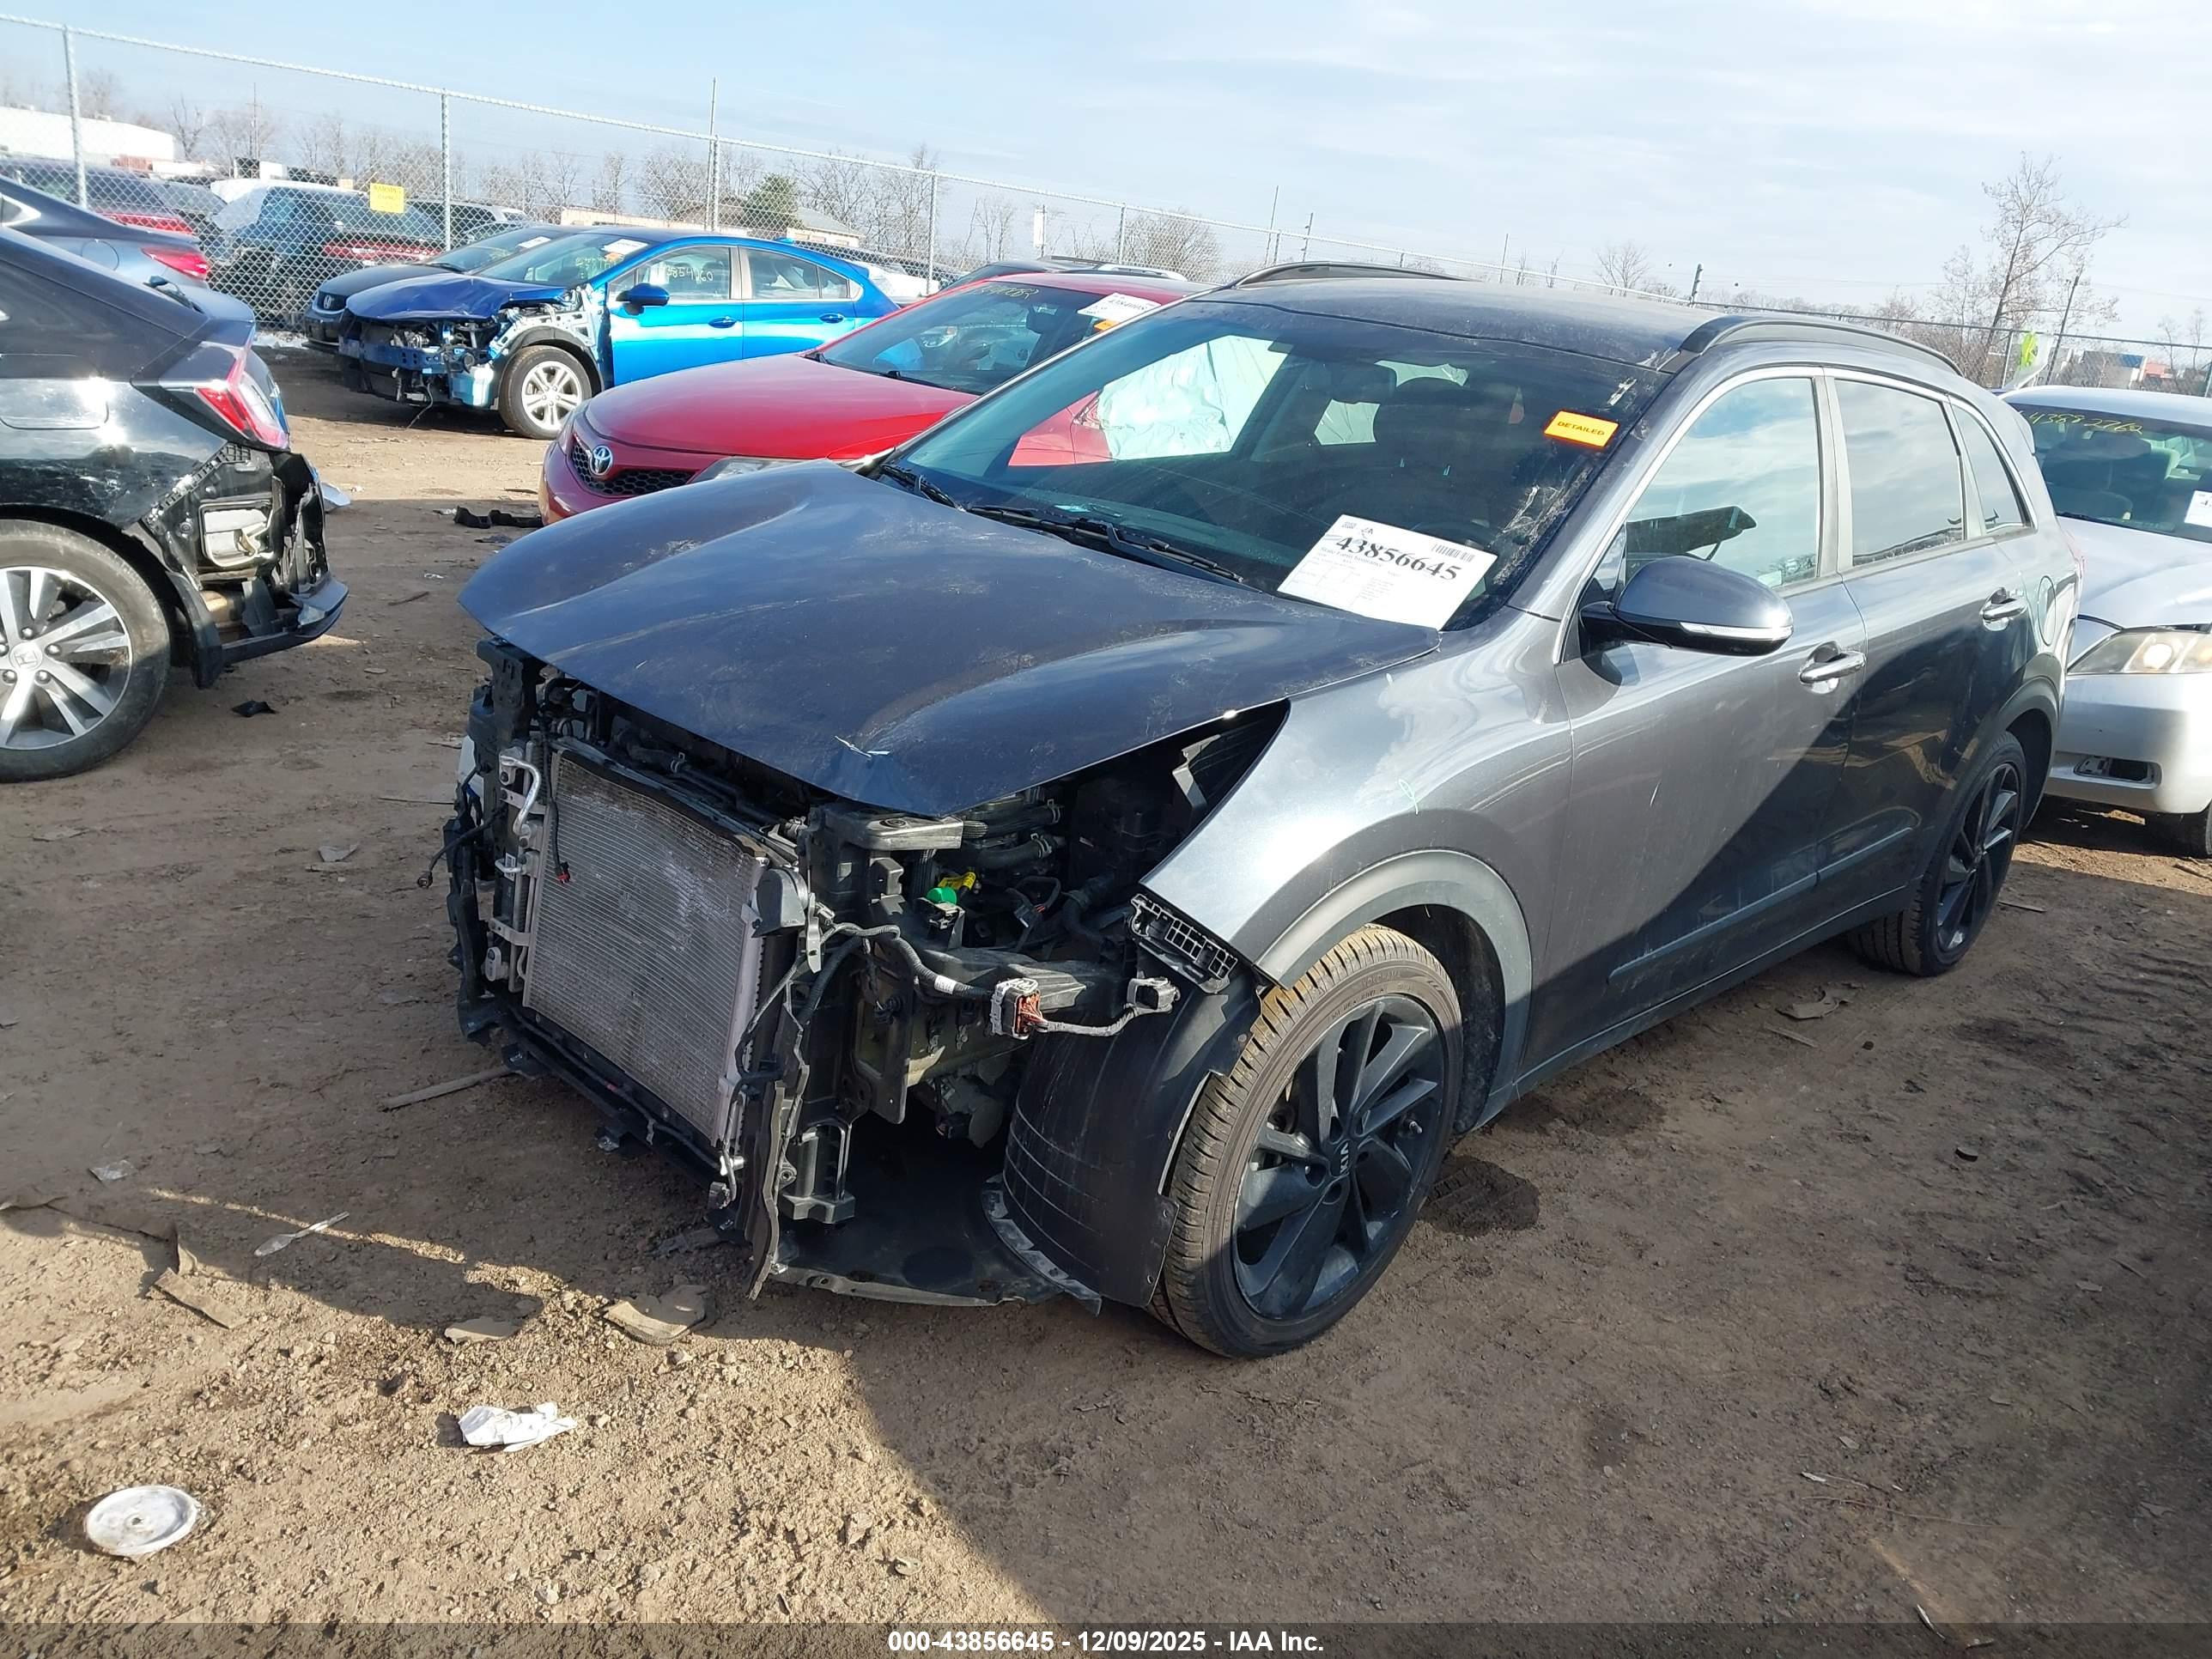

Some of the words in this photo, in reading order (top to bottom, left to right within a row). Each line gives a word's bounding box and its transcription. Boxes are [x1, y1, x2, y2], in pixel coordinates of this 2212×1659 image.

[1557, 421, 1605, 435] DETAILED
[1336, 537, 1462, 580] 43856645
[1340, 1142, 1349, 1174] KIA
